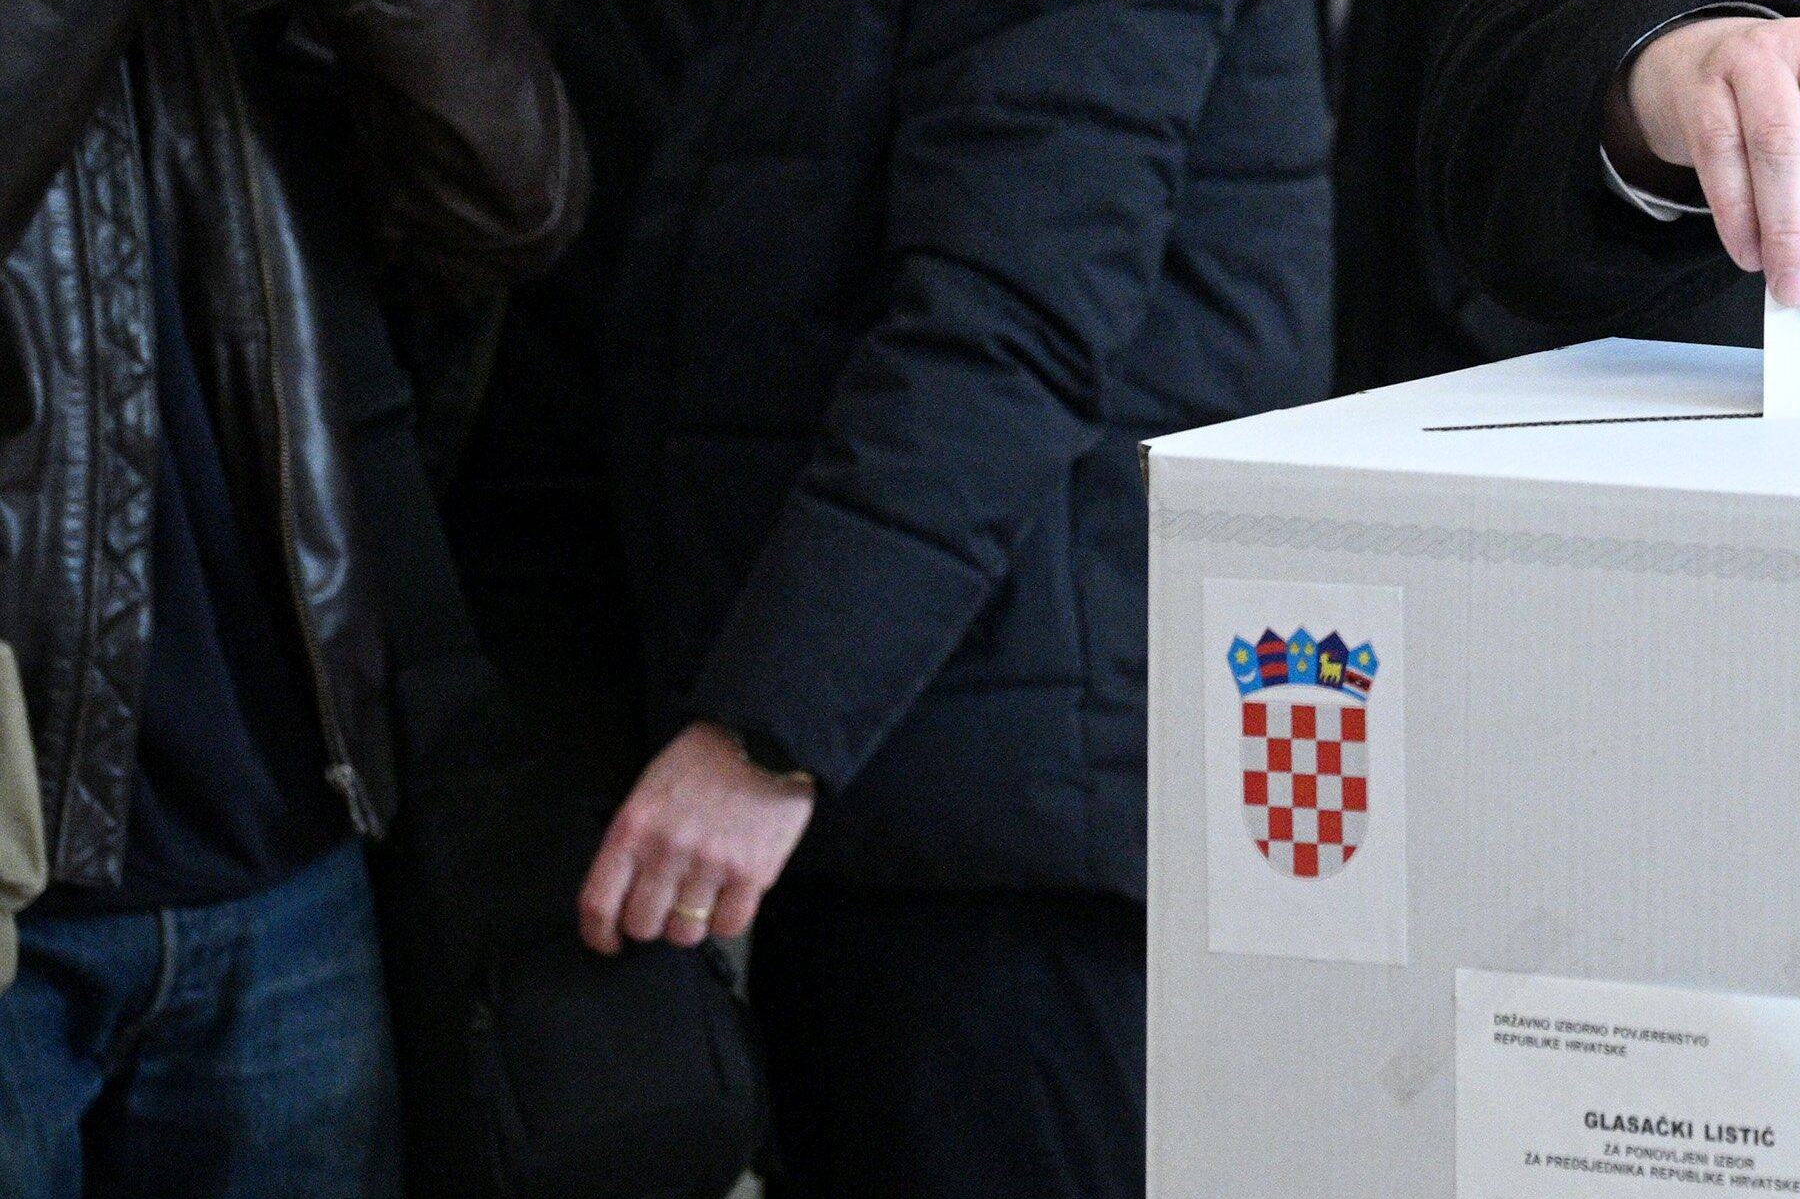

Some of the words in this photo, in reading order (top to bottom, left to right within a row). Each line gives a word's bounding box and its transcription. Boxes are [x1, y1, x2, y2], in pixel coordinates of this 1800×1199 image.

[1493, 1013, 1551, 1031] DRŽAVNO
[1554, 1018, 1609, 1037] IZBORNO
[1613, 1025, 1709, 1048] POVJERENSTVO
[1493, 1032, 1560, 1051] REPUBLIKE
[1565, 1039, 1627, 1058] HRVATSKE
[1583, 1110, 1694, 1140] GLASAČKI
[1703, 1123, 1777, 1147] LISTIĆ
[1524, 1151, 1542, 1167] ZA
[1546, 1155, 1645, 1178] PREDSJEDNIKA
[1650, 1166, 1725, 1188] REPUBLIKE
[1729, 1175, 1800, 1194] HRVATSKE
[1603, 1142, 1621, 1157] ZA
[1625, 1145, 1710, 1167] PONOVLJENI
[1714, 1154, 1755, 1170] IZBOR
